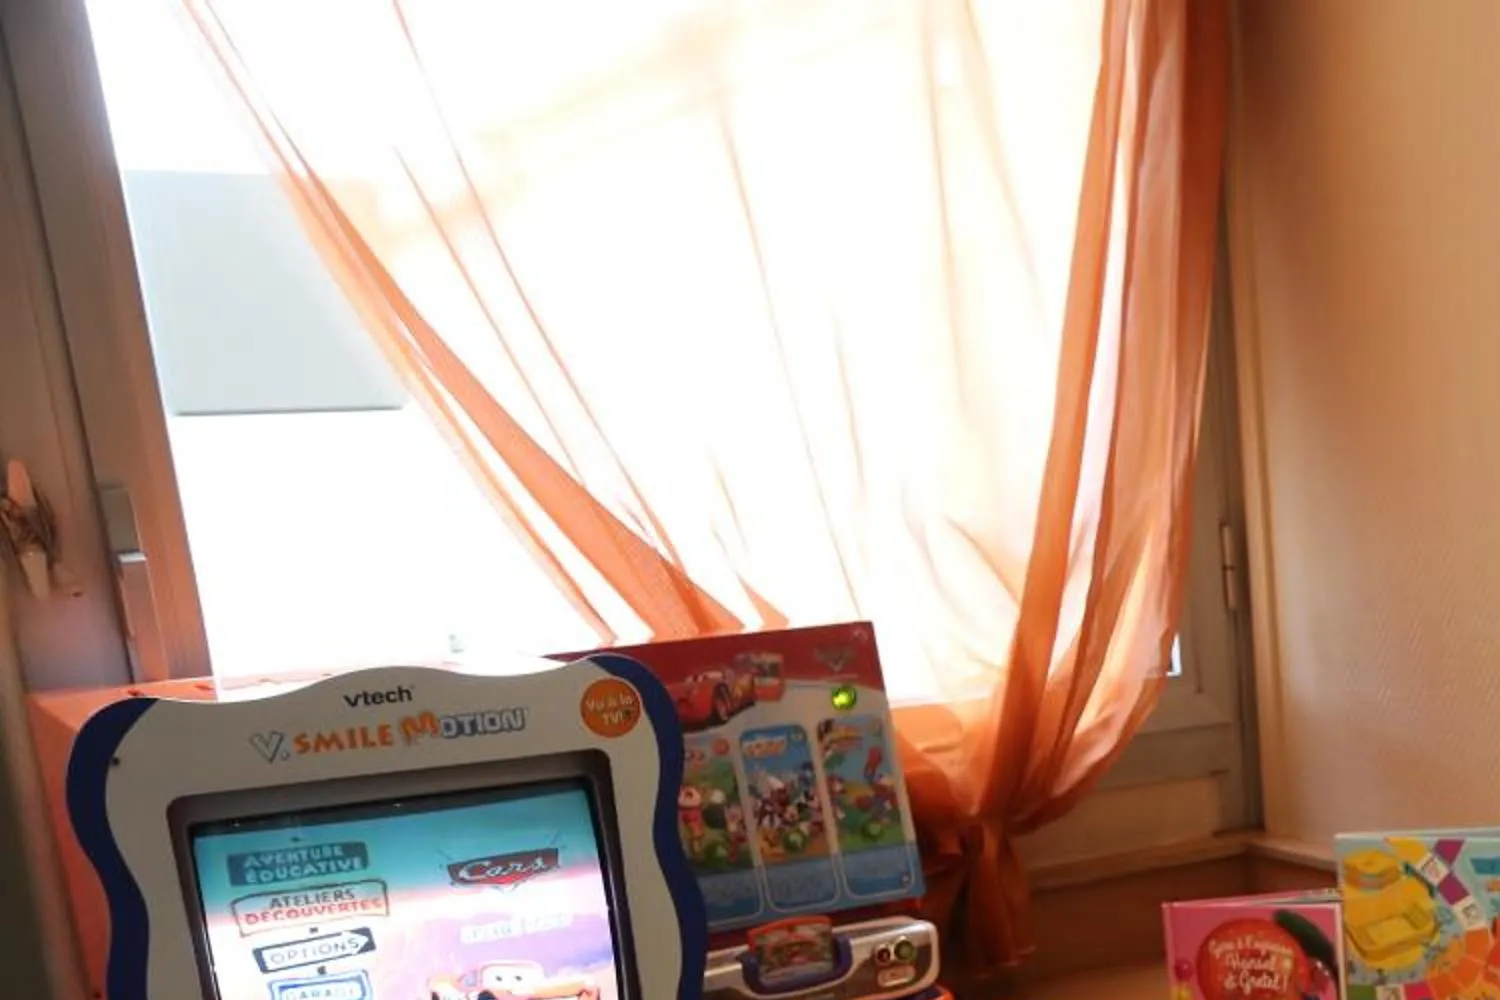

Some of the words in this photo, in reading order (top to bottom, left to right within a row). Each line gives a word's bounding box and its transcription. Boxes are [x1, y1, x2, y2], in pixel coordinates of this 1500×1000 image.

[344, 686, 413, 708] vtech
[400, 708, 526, 746] MOTION
[243, 845, 345, 868] AVENTURE
[459, 857, 547, 880] Cars
[269, 887, 356, 910] ATELIERS
[270, 938, 360, 964] OPTIONS
